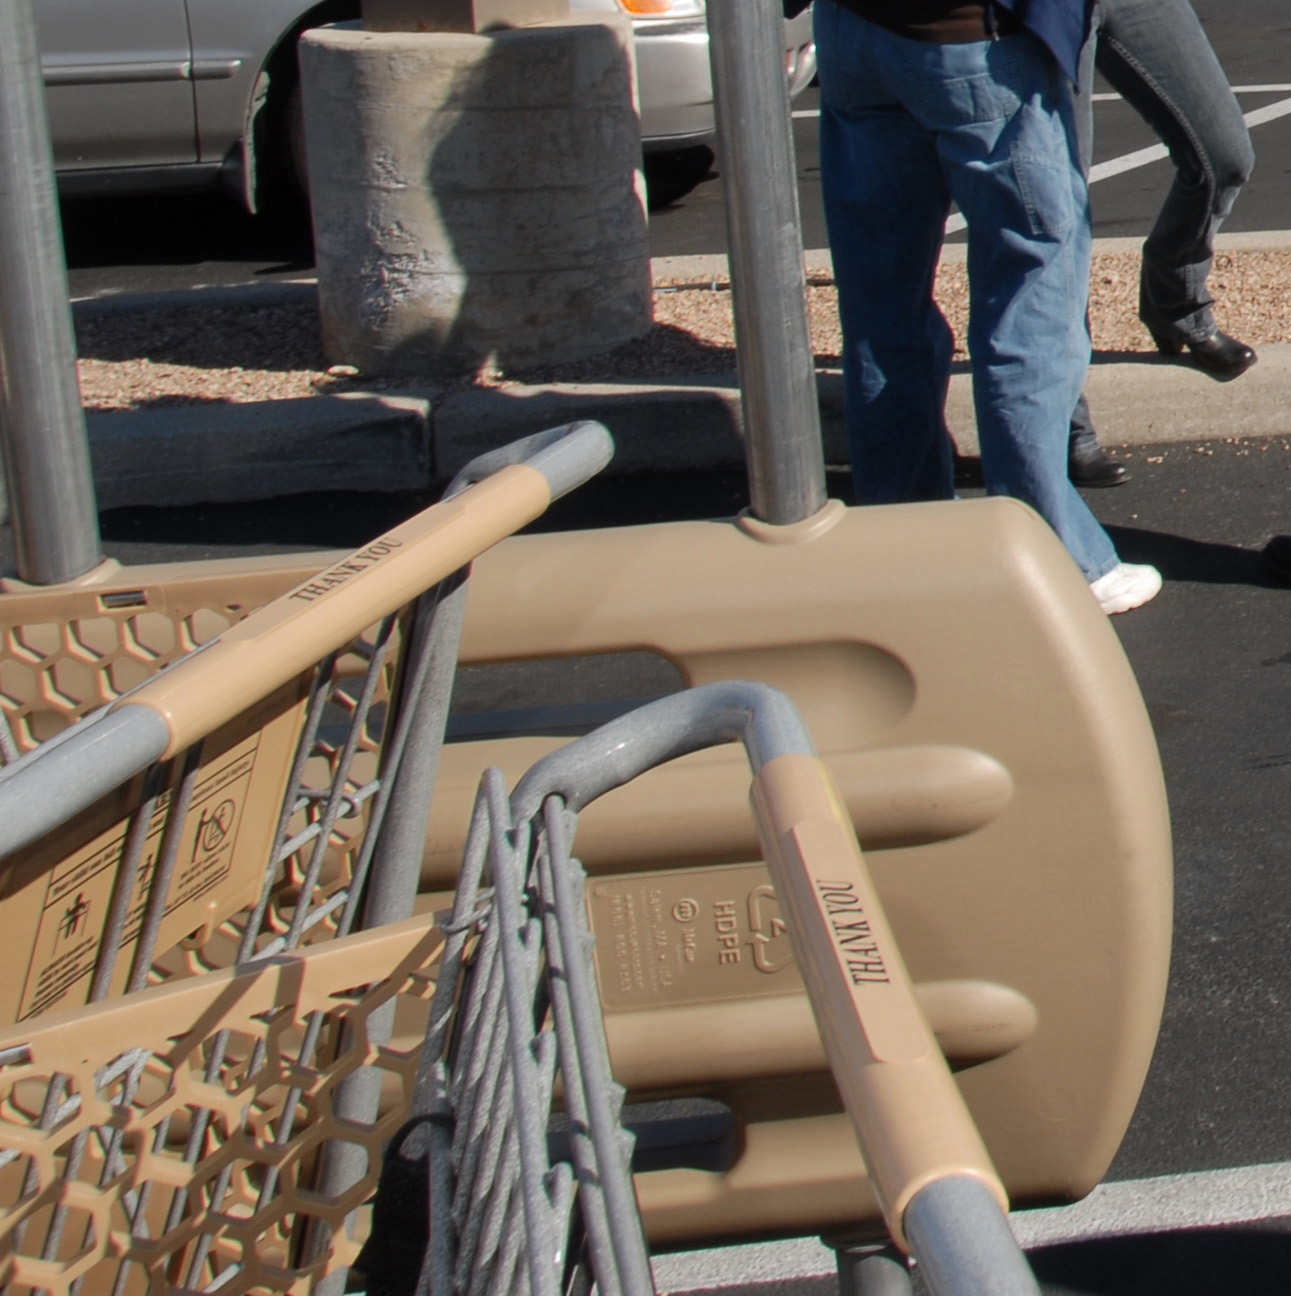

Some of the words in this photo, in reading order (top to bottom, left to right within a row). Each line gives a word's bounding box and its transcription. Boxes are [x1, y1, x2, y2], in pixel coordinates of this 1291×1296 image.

[288, 560, 368, 601] THANK
[355, 537, 403, 562] YOU
[816, 879, 863, 914] YOU
[713, 900, 741, 965] HDPE
[832, 920, 889, 985] THANK
